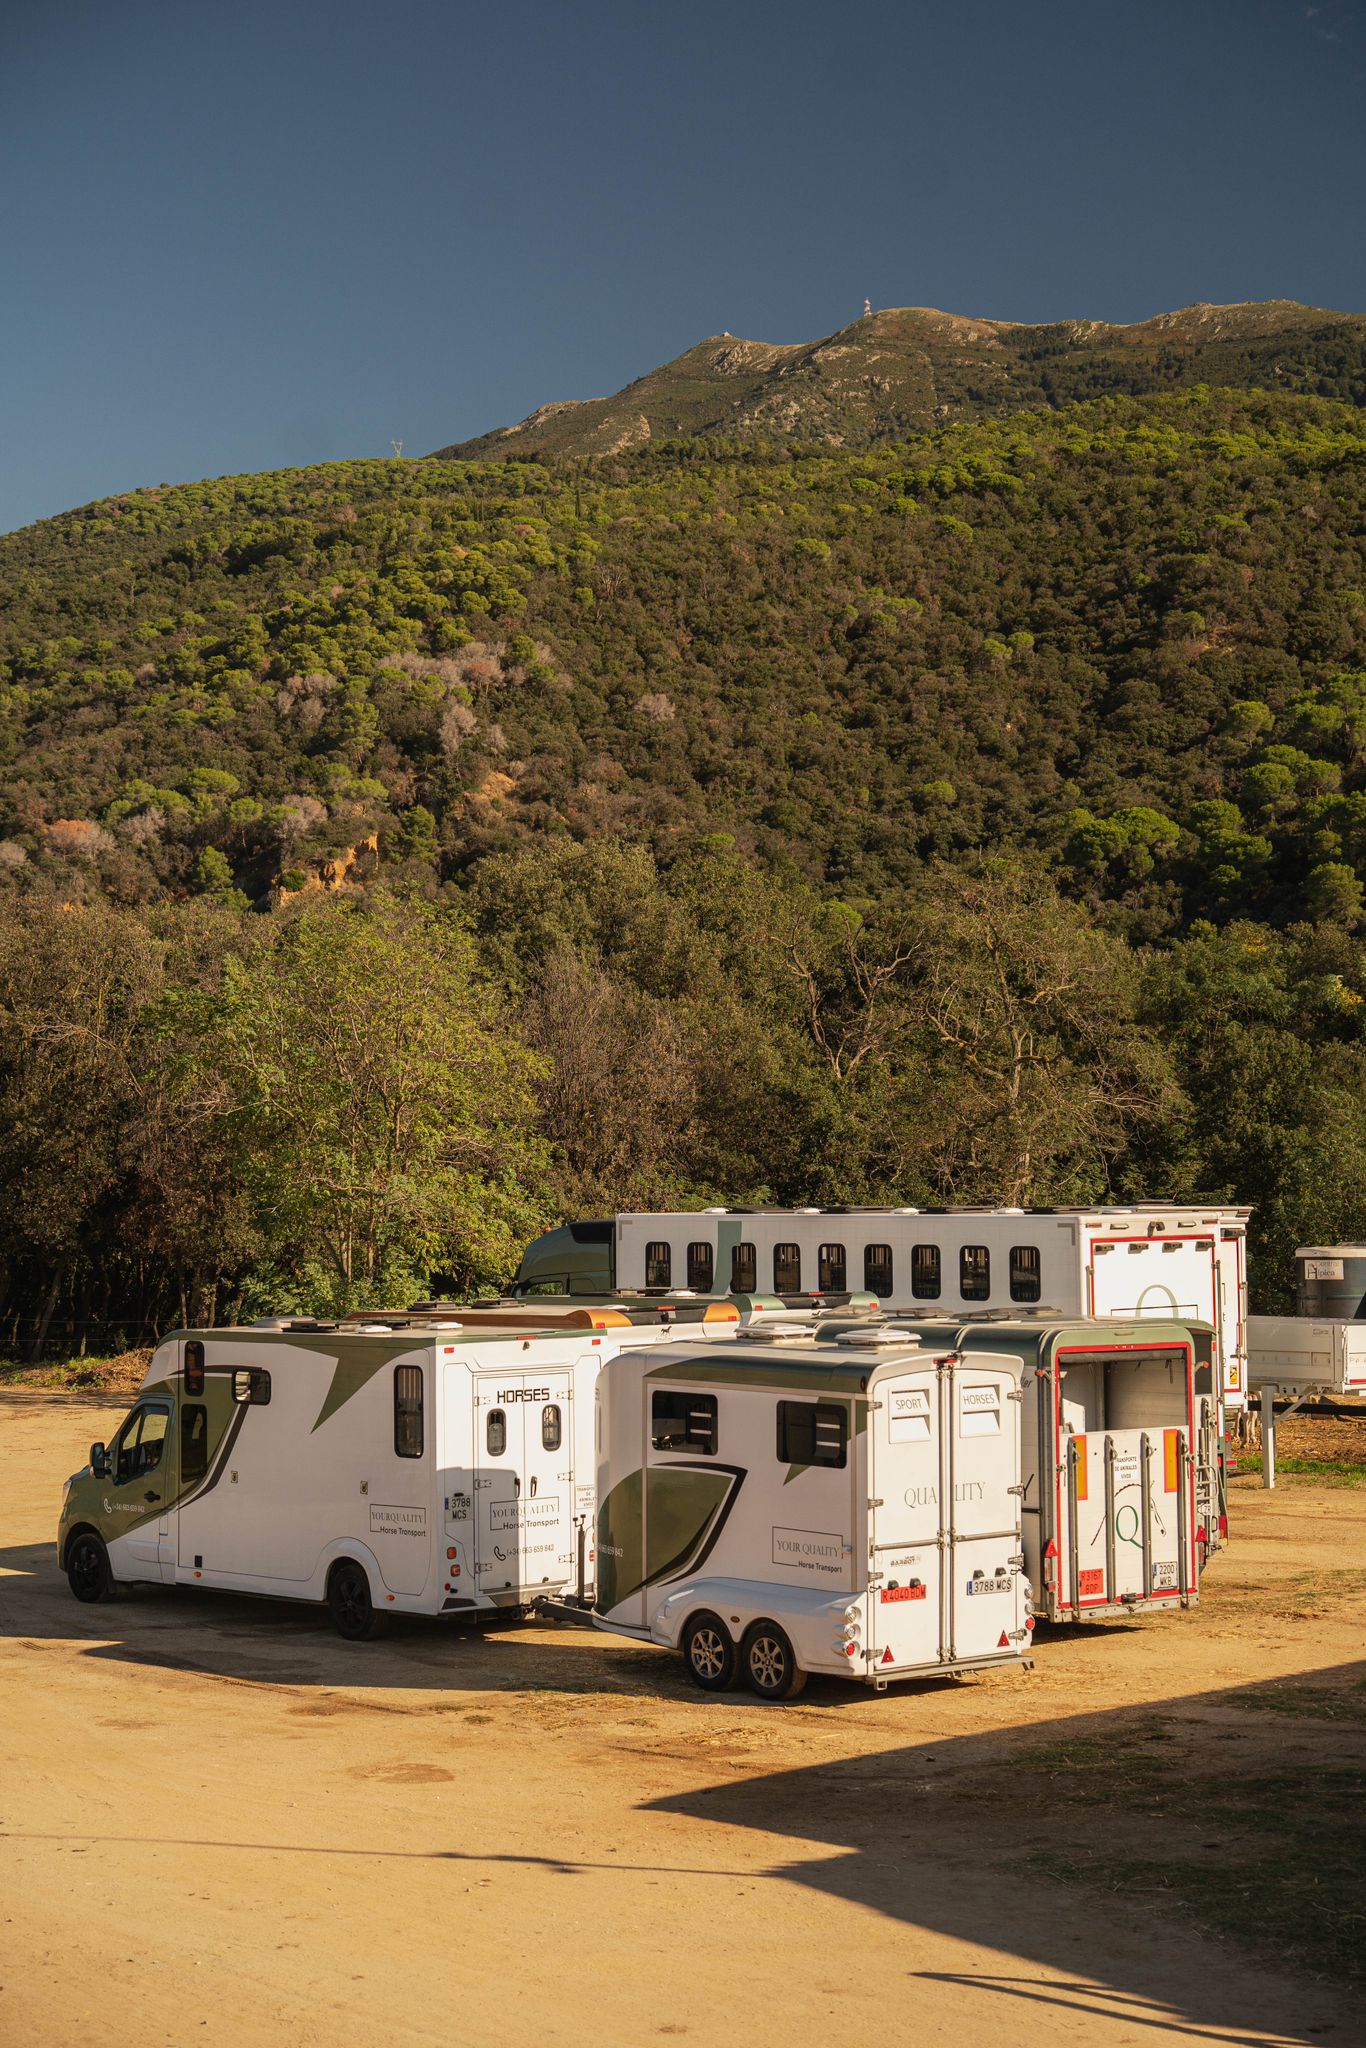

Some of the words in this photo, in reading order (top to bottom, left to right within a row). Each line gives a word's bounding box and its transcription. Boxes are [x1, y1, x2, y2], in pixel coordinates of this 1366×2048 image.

[497, 1388, 550, 1404] HORSES
[962, 1394, 995, 1405] HORSES
[895, 1398, 922, 1410] SPORT
[451, 1497, 471, 1509] 3788
[451, 1509, 467, 1520] MCS
[502, 1521, 525, 1530] Horse
[526, 1518, 560, 1528] Transport
[379, 1526, 398, 1535] Horse
[399, 1527, 427, 1538] Transport
[776, 1540, 801, 1553] YOUR
[801, 1543, 840, 1558] QUALITY
[798, 1561, 815, 1570] Horse
[815, 1562, 843, 1574] Transport
[1158, 1564, 1176, 1575] 2200
[974, 1580, 995, 1592] 3788
[996, 1578, 1012, 1590] MCS
